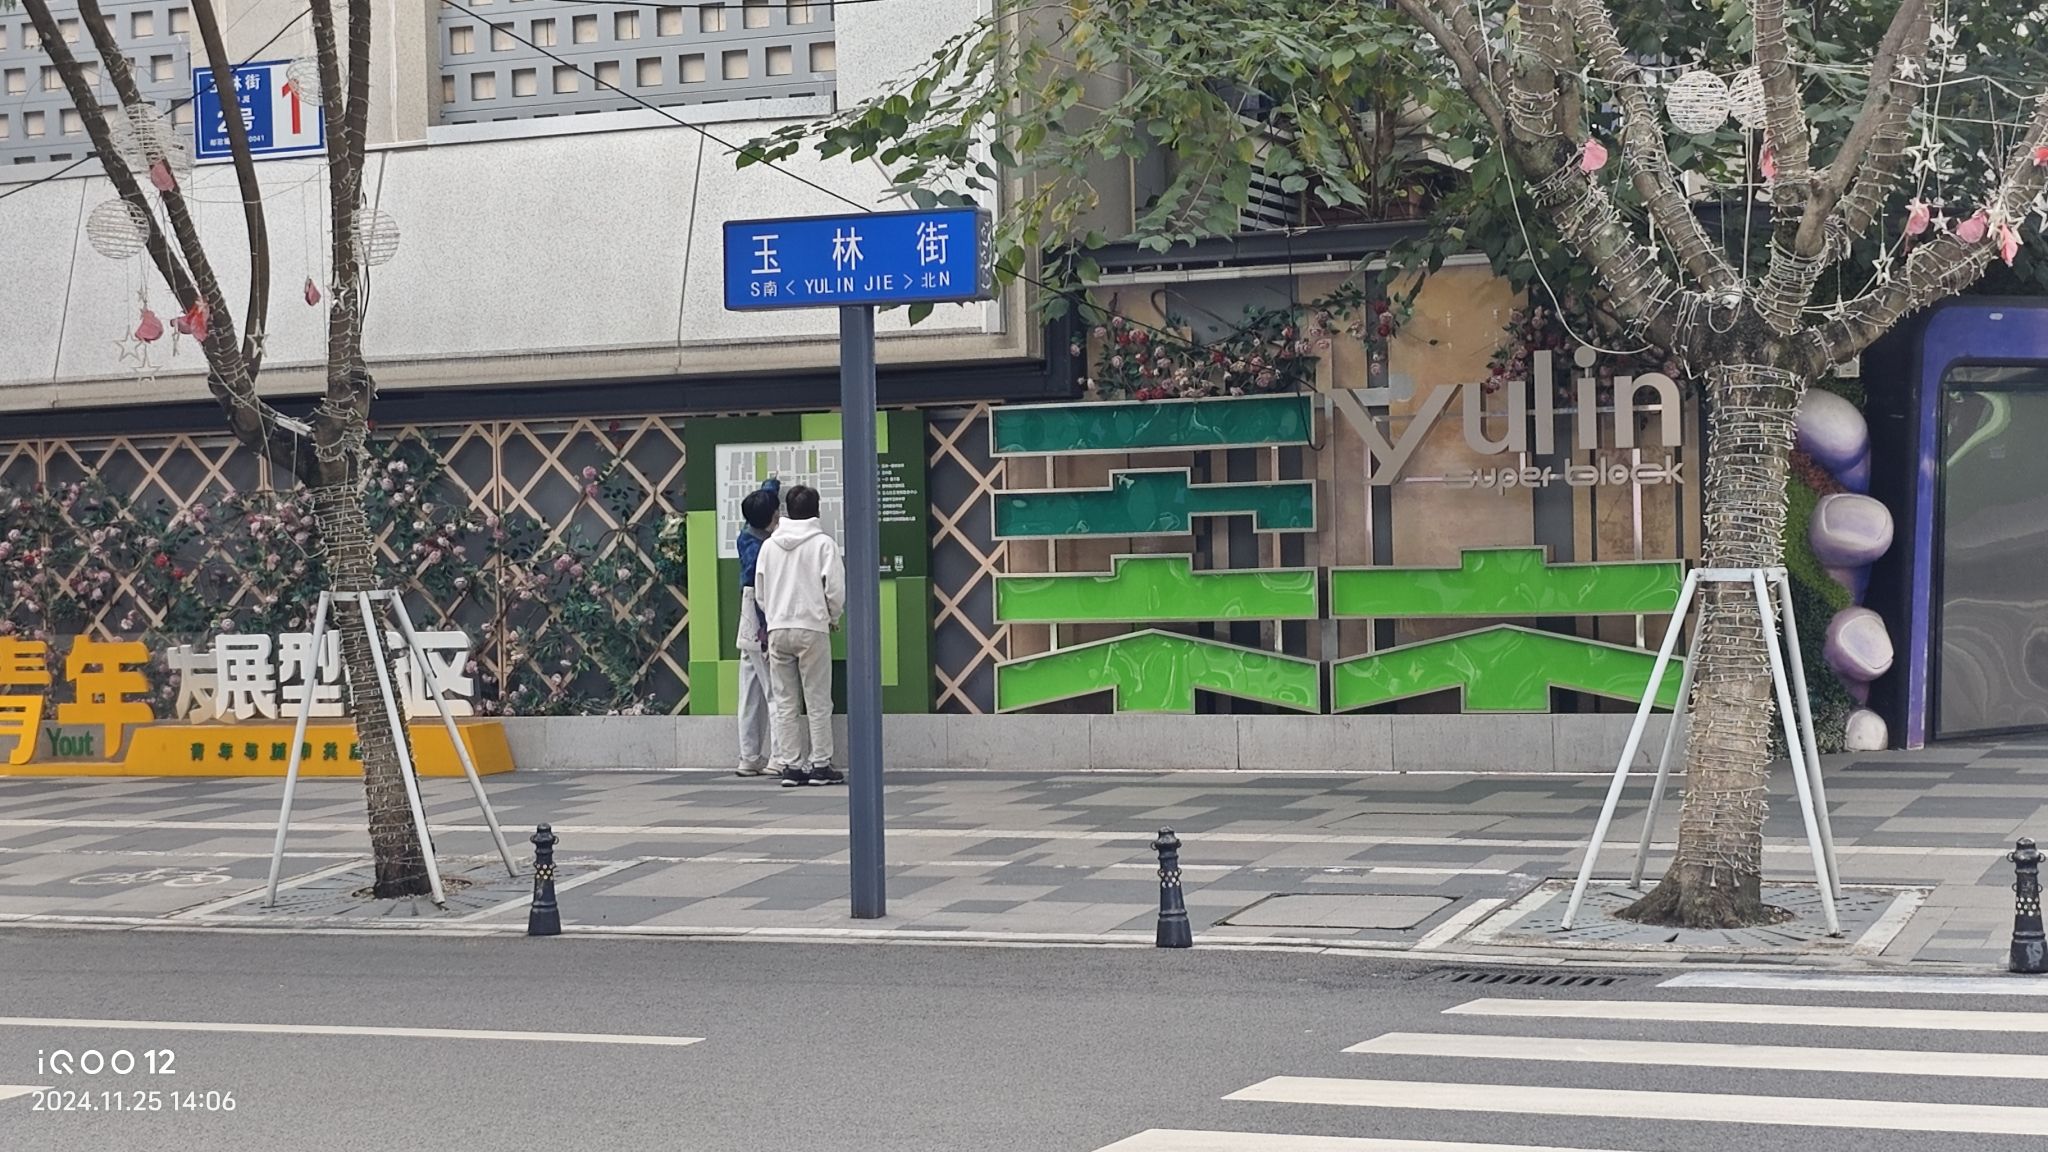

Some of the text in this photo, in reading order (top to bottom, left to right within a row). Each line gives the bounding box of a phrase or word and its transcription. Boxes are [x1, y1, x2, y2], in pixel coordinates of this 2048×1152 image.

[751, 221, 949, 275] 玉林街
[804, 276, 854, 294] YULIN
[864, 274, 893, 291] JIE
[1329, 346, 1681, 486] yulin
[1443, 455, 1686, 497] super block
[167, 629, 475, 725] 发展型区
